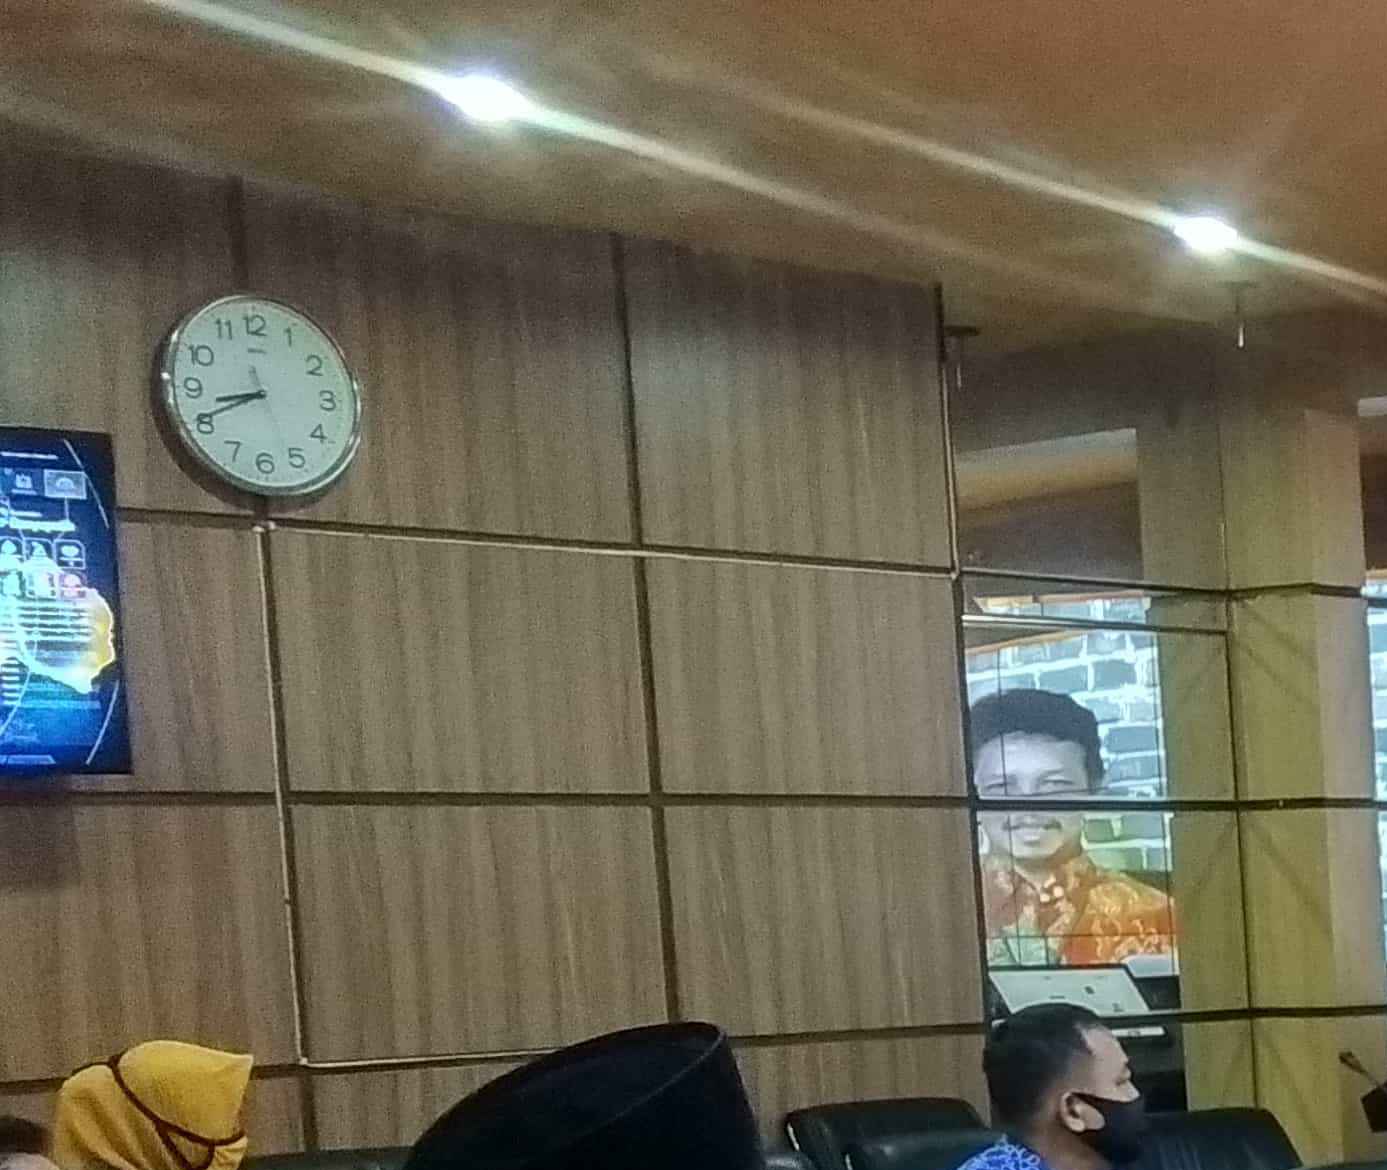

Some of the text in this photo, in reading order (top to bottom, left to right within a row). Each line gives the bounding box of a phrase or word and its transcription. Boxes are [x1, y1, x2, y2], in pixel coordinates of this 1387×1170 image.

[214, 317, 233, 340] 11
[243, 314, 268, 337] 12
[283, 327, 293, 347] 1
[188, 344, 215, 367] 10
[304, 354, 324, 377] 2
[183, 376, 203, 400] 9
[319, 390, 337, 412] 3
[196, 412, 215, 435] 8
[309, 423, 328, 444] 4
[224, 440, 242, 462] 7
[287, 447, 306, 469] 5
[255, 452, 275, 474] 6
